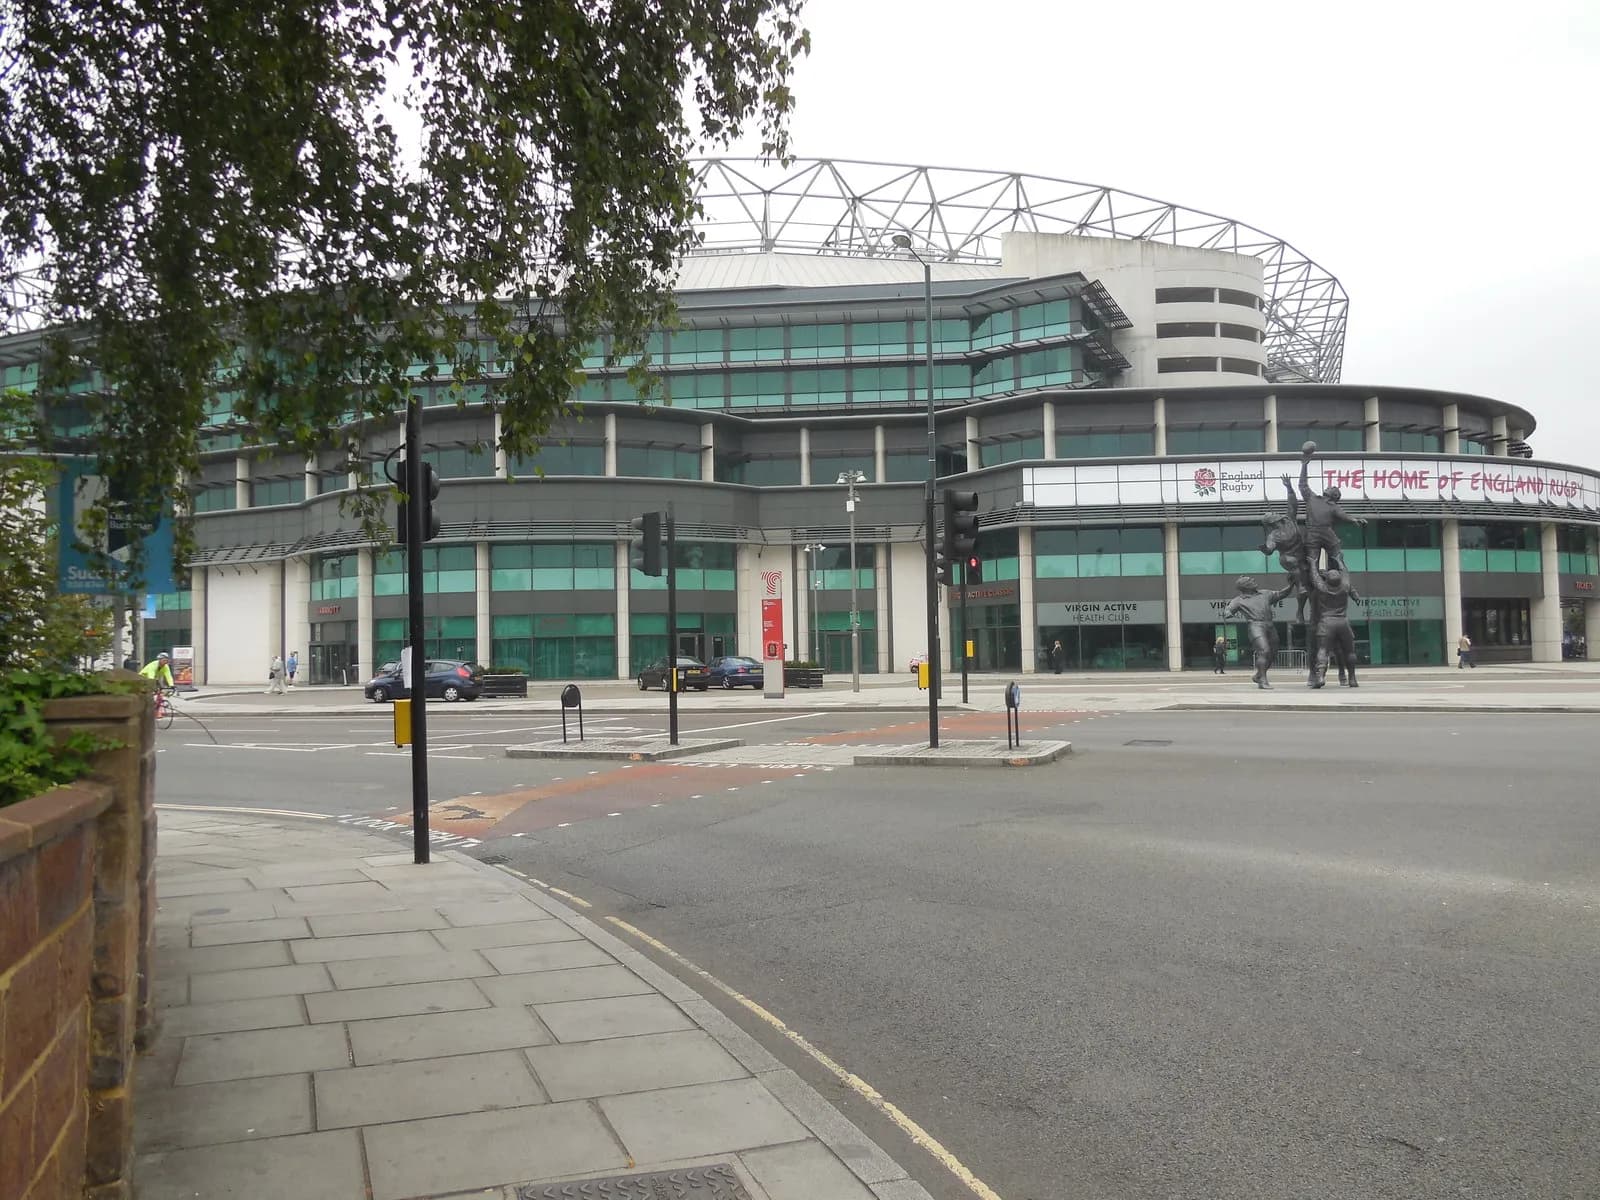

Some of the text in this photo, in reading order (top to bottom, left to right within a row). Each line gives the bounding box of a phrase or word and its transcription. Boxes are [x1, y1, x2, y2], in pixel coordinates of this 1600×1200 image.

[1221, 470, 1263, 482] England
[1221, 482, 1254, 494] Rugby
[1324, 469, 1584, 500] THE HOME OF ENGLAND RUGBY
[1065, 603, 1137, 612] VIRGIN ACTIVE
[1355, 598, 1420, 607] VIRGIN ACTIVE
[1073, 613, 1130, 622] HEALTH CLUB
